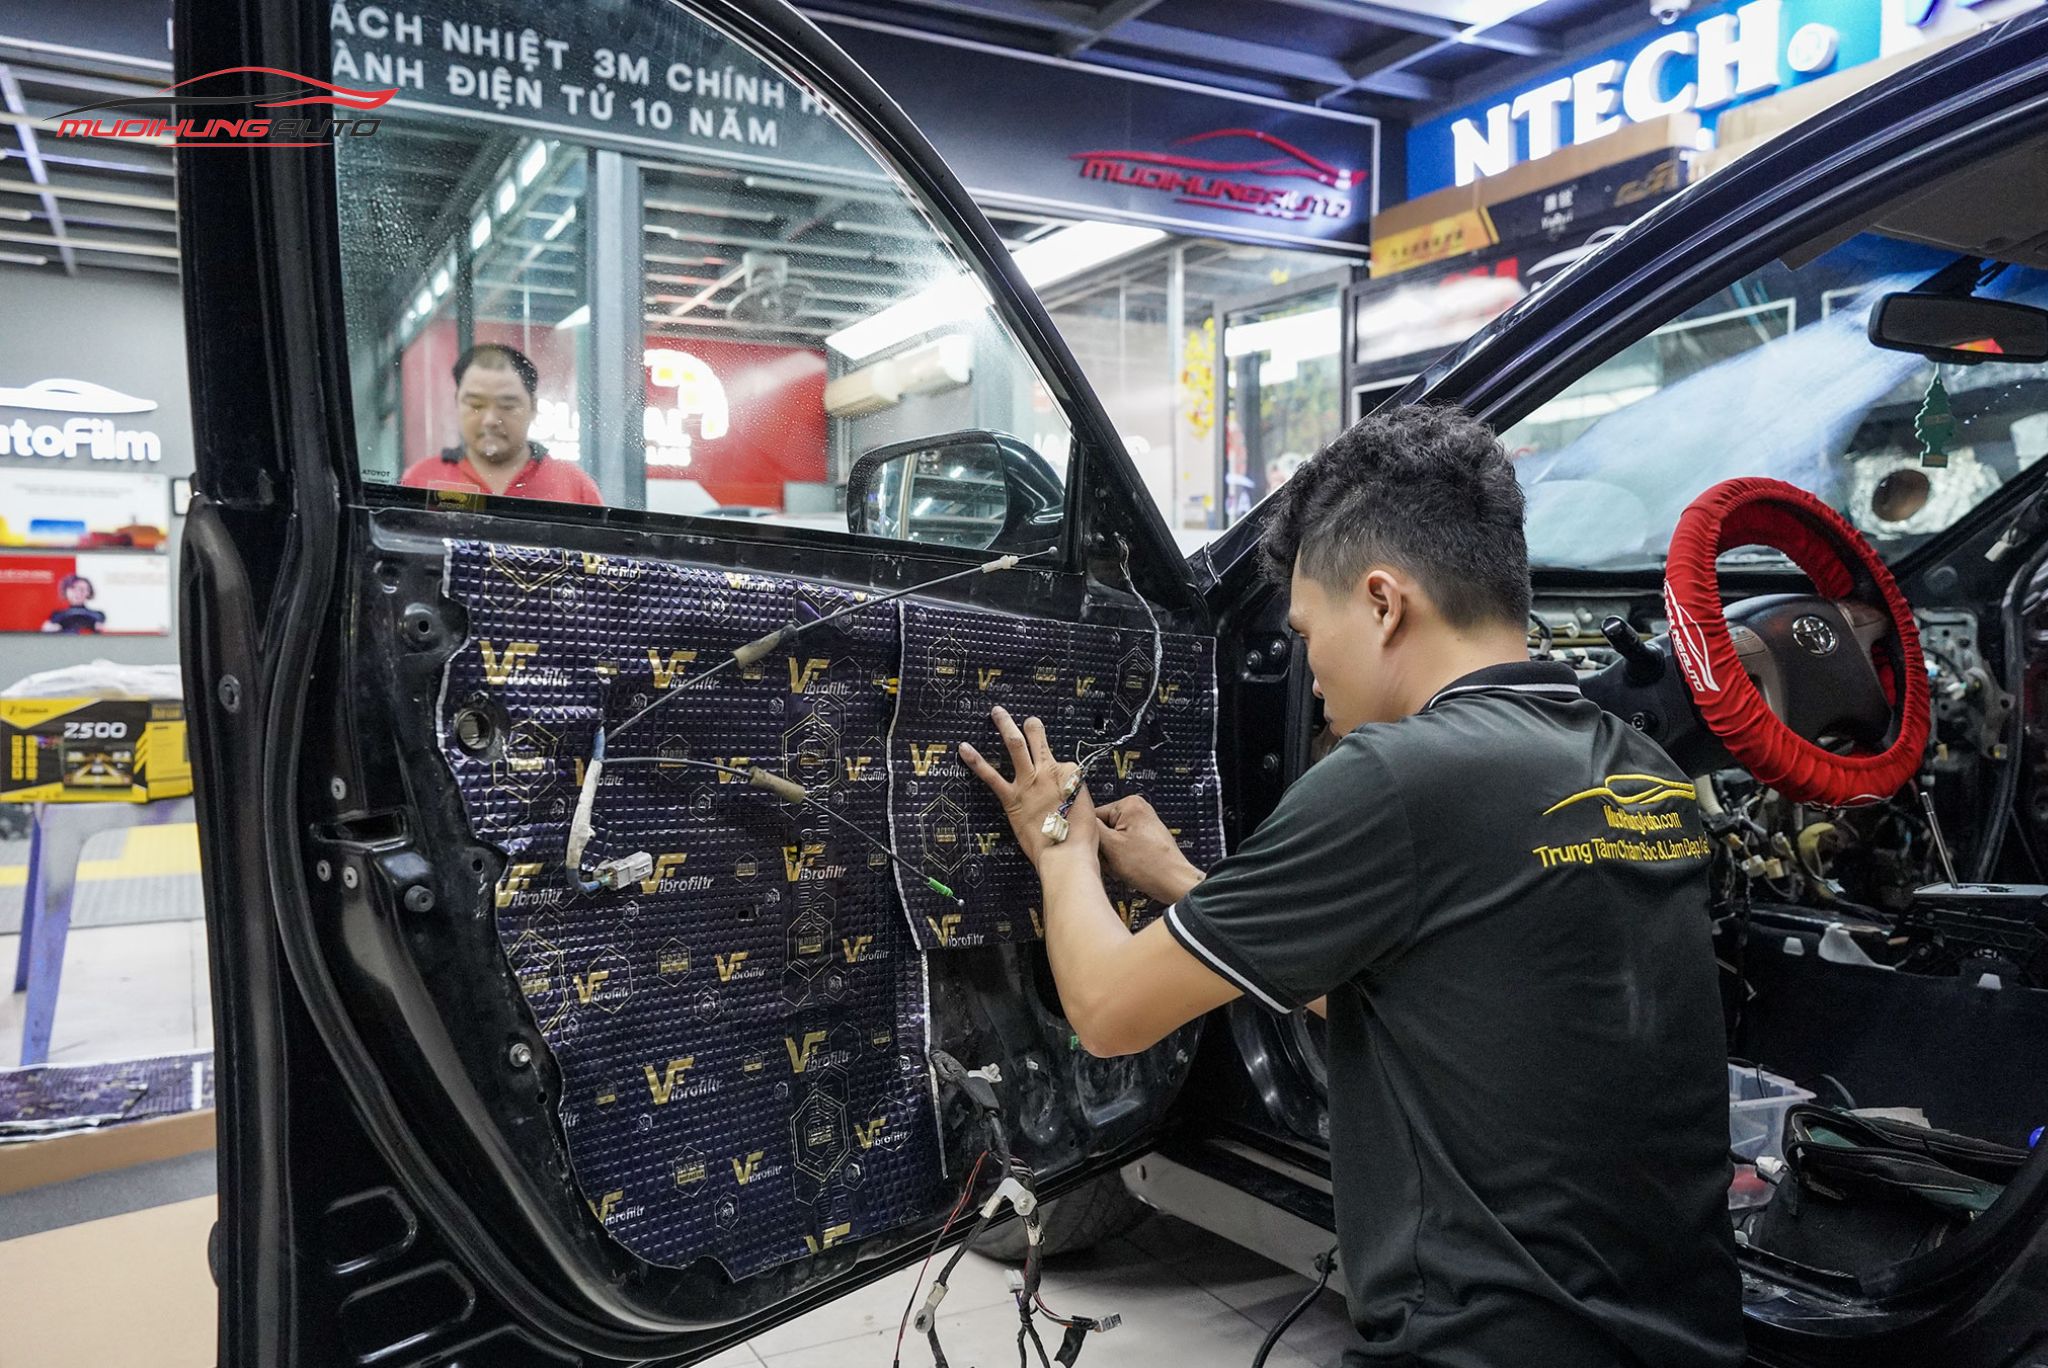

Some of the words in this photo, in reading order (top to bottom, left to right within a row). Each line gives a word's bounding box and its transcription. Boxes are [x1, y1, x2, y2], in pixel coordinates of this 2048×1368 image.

[443, 20, 570, 73] NHIỆT
[594, 48, 651, 87] 3M
[666, 63, 785, 110] CHÍNH
[446, 64, 543, 110] ĐIỆN
[560, 82, 616, 121] TỬ
[630, 97, 674, 131] 10
[688, 107, 778, 148] NĂM
[1533, 843, 1593, 868] Trung
[1591, 837, 1617, 859] Tâm
